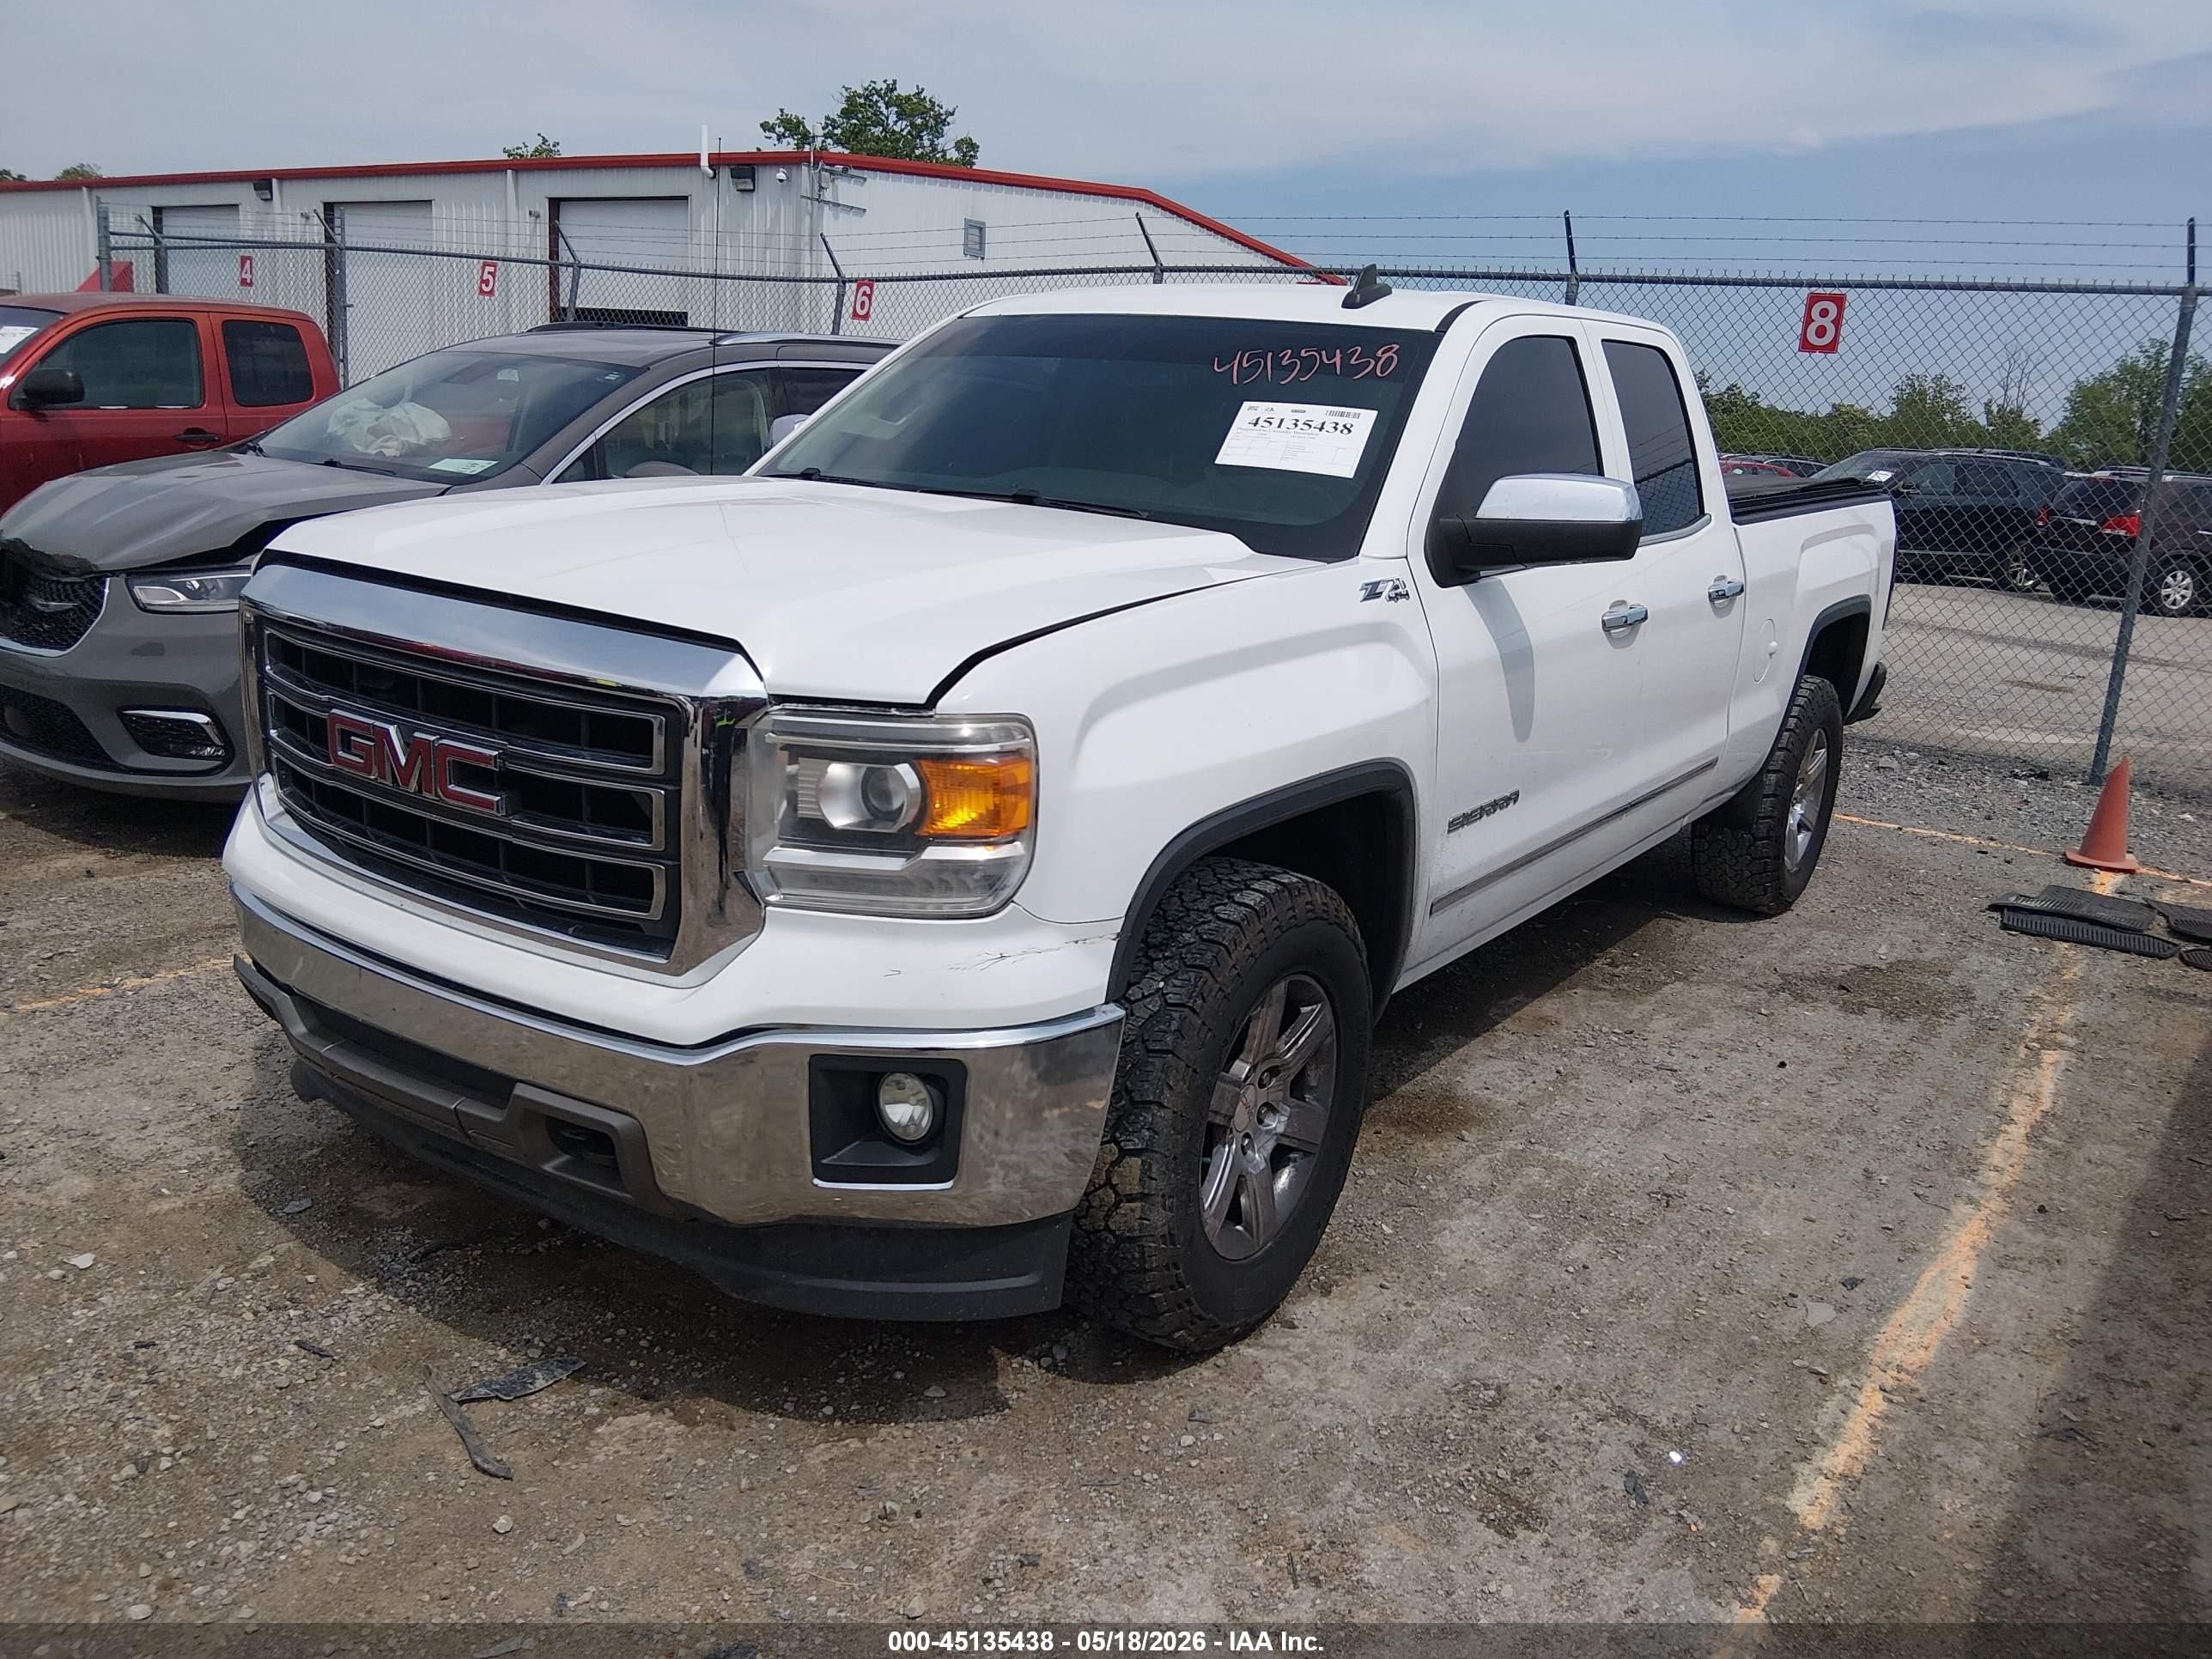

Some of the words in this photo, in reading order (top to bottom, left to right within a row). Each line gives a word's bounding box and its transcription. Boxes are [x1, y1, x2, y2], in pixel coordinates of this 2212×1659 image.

[241, 259, 252, 283] 4
[481, 265, 495, 292] 5
[855, 285, 870, 316] 6
[1806, 301, 1838, 346] 8
[1213, 343, 1401, 385] 45135438
[1248, 416, 1354, 435] 45135438
[327, 708, 508, 816] GMC
[1447, 789, 1520, 835] SIERRA
